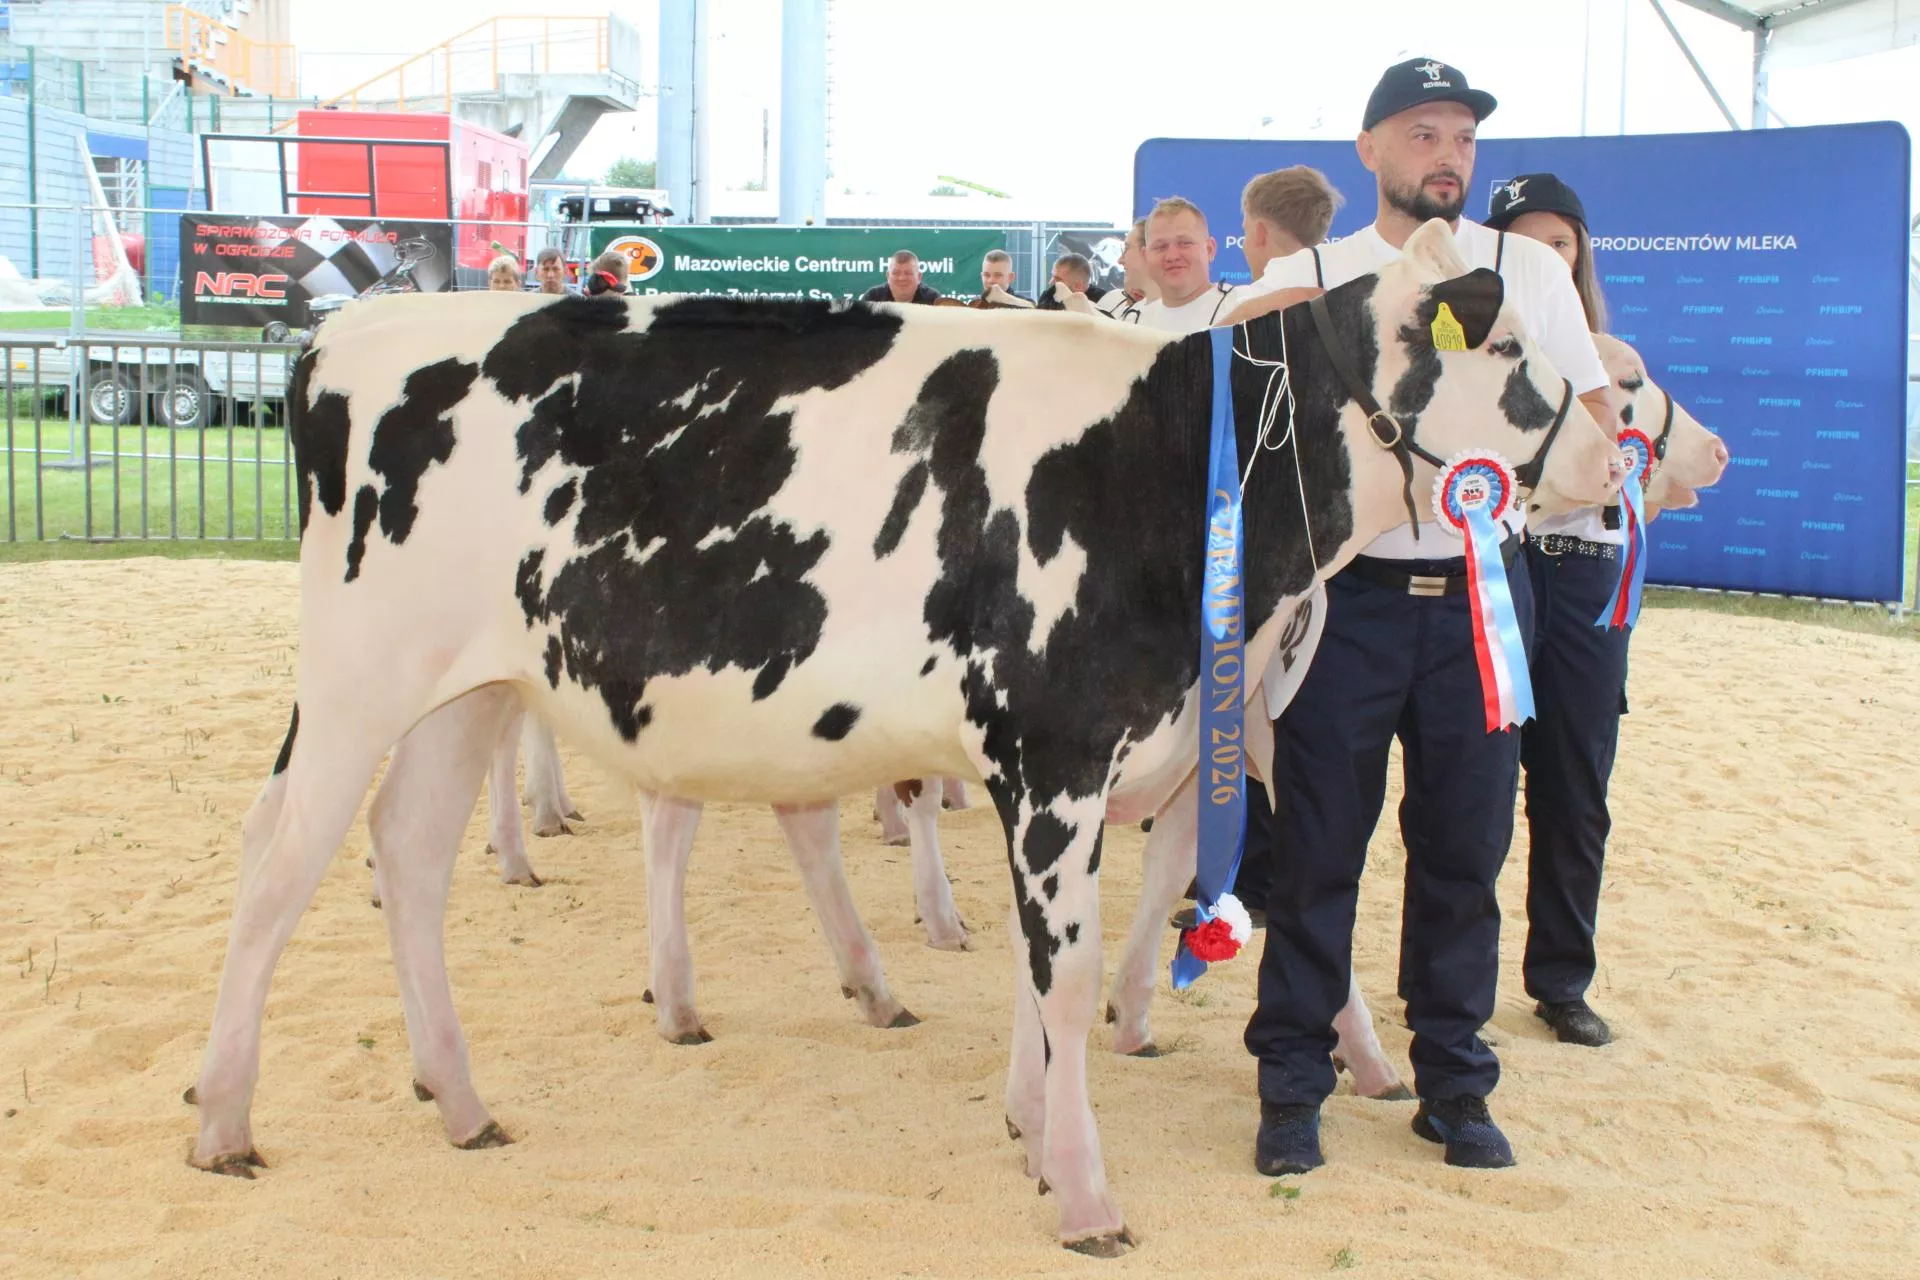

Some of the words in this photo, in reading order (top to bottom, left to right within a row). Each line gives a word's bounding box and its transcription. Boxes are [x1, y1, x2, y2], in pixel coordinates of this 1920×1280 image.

[193, 243, 208, 256] W
[215, 243, 296, 258] OGRODZIE
[1590, 232, 1732, 251] PRODUCENTÓW
[1736, 234, 1797, 250] MLEKA
[674, 255, 790, 272] Mazowieckie
[795, 255, 874, 273] Centrum
[879, 256, 953, 273] Howli
[194, 271, 288, 298] NAC
[1210, 727, 1241, 806] 2026
